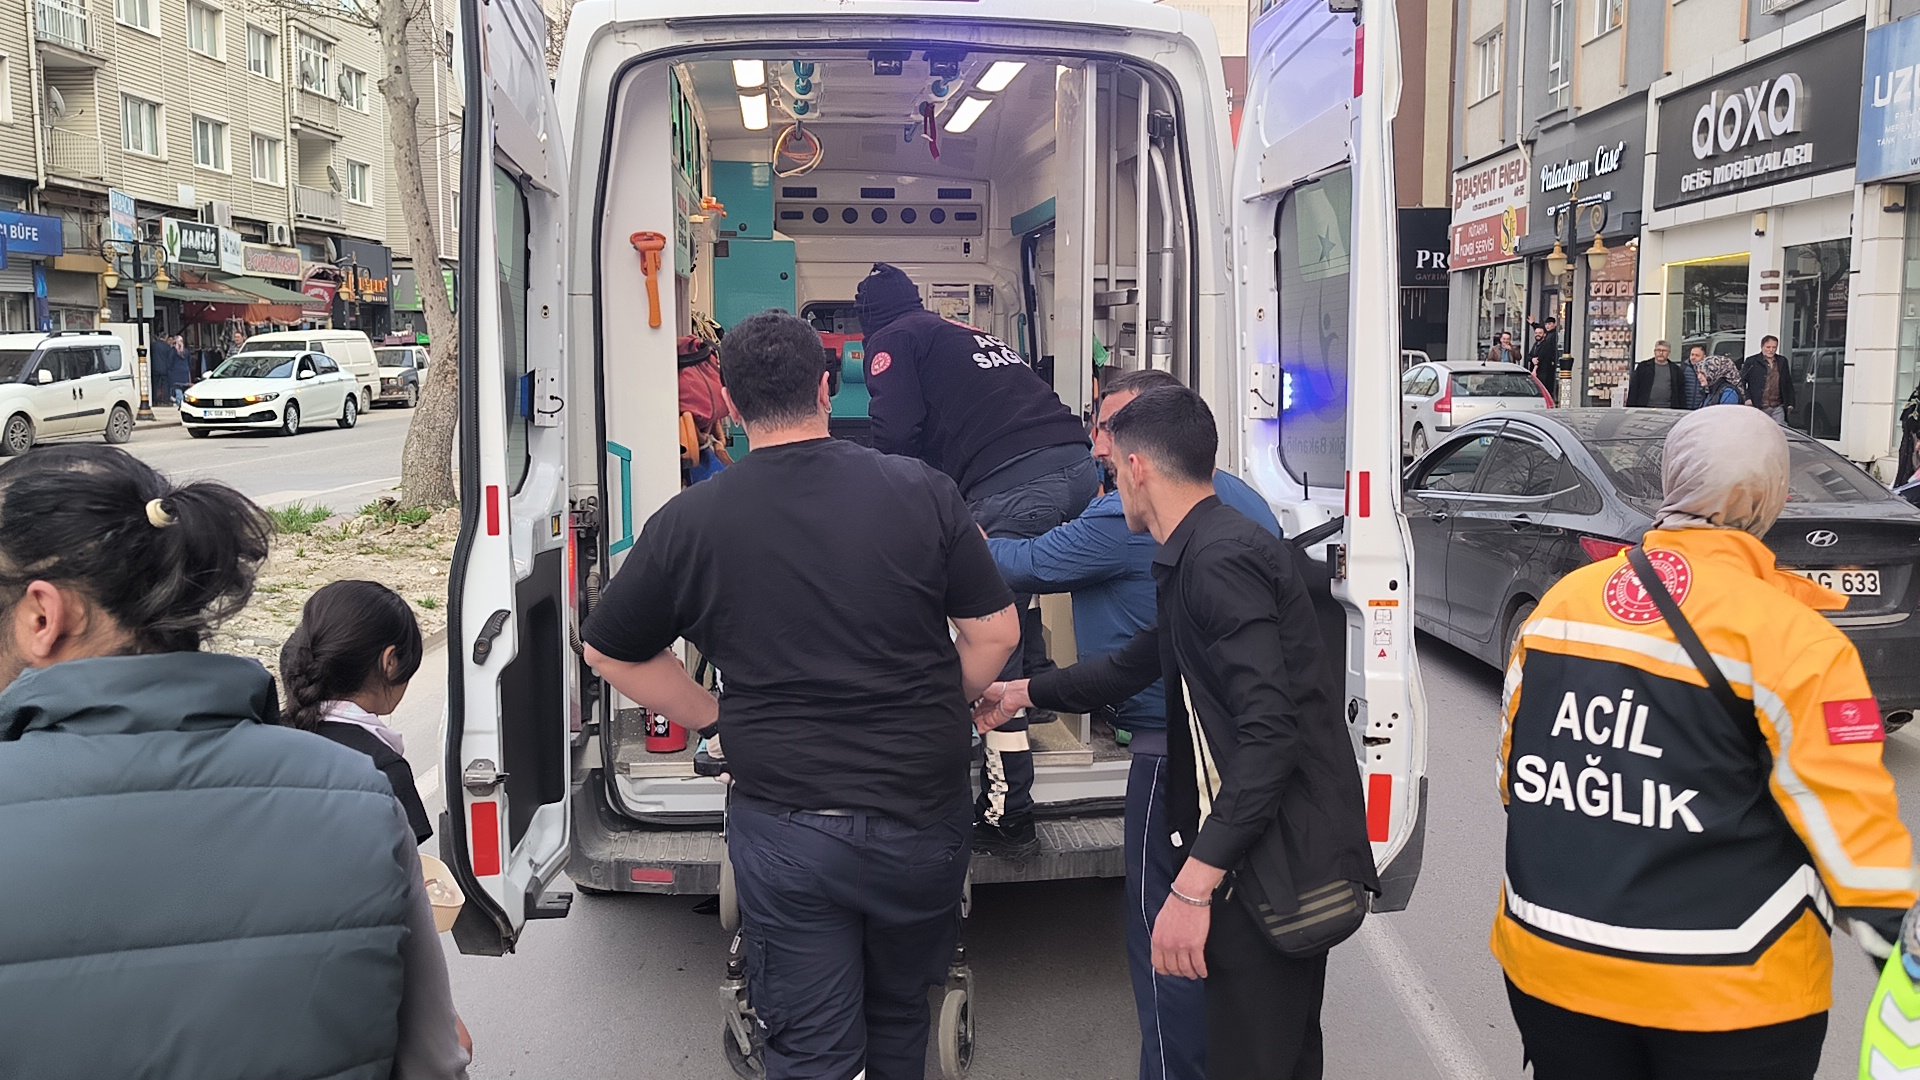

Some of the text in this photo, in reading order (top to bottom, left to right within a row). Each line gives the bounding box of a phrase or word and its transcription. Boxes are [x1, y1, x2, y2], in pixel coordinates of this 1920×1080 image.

[1692, 73, 1800, 160] doxa
[1713, 143, 1813, 185] MOBİLYALARI
[1463, 167, 1498, 201] BAŞKENT
[10, 222, 39, 242] BÜFE
[181, 227, 217, 253] KAKTÜS
[1842, 572, 1878, 593] 633
[1551, 688, 1663, 759] ACİL
[1514, 753, 1704, 833] SAĞLIK
